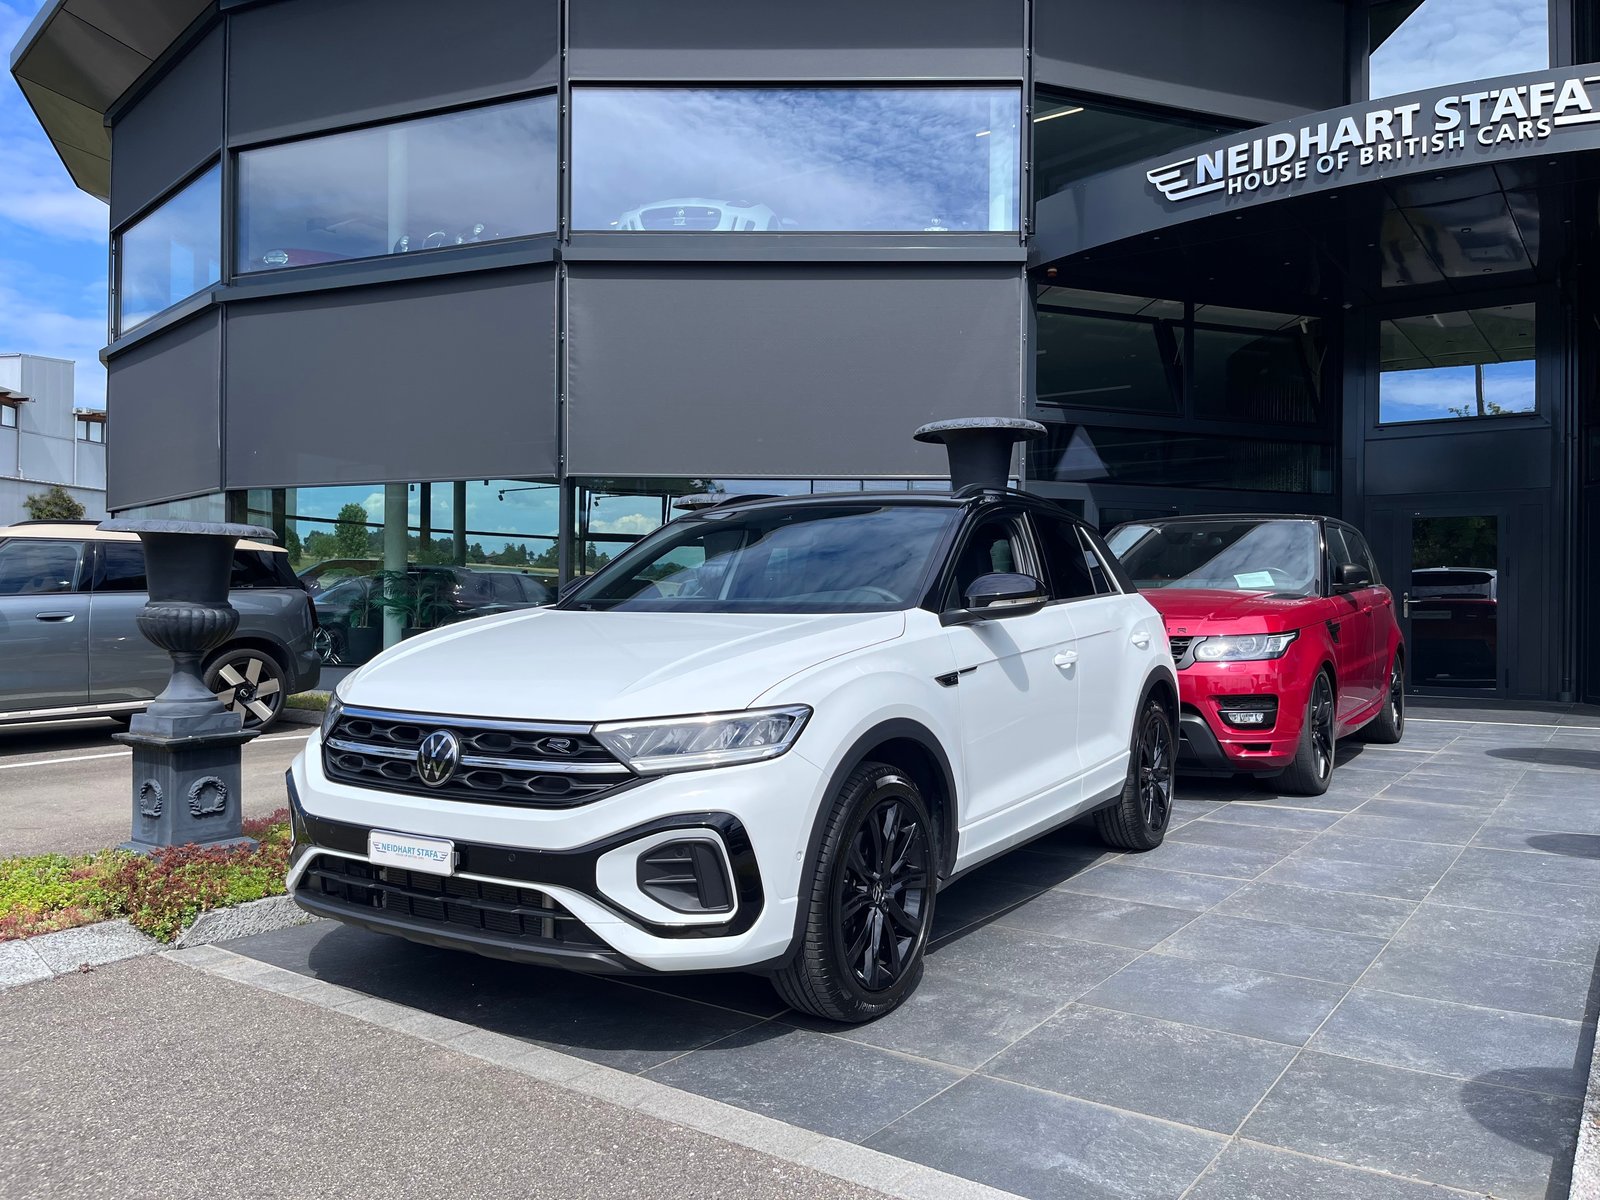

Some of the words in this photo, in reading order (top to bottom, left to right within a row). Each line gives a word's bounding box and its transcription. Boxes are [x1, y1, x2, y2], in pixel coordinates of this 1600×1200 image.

[1196, 103, 1421, 185] NEIDHART
[1434, 78, 1593, 131] STÄFA
[1228, 160, 1307, 195] HOUSE
[1316, 151, 1349, 174] OF
[1360, 129, 1465, 166] BRITISH
[1477, 118, 1552, 145] CARS
[381, 842, 416, 855] NEIDHART
